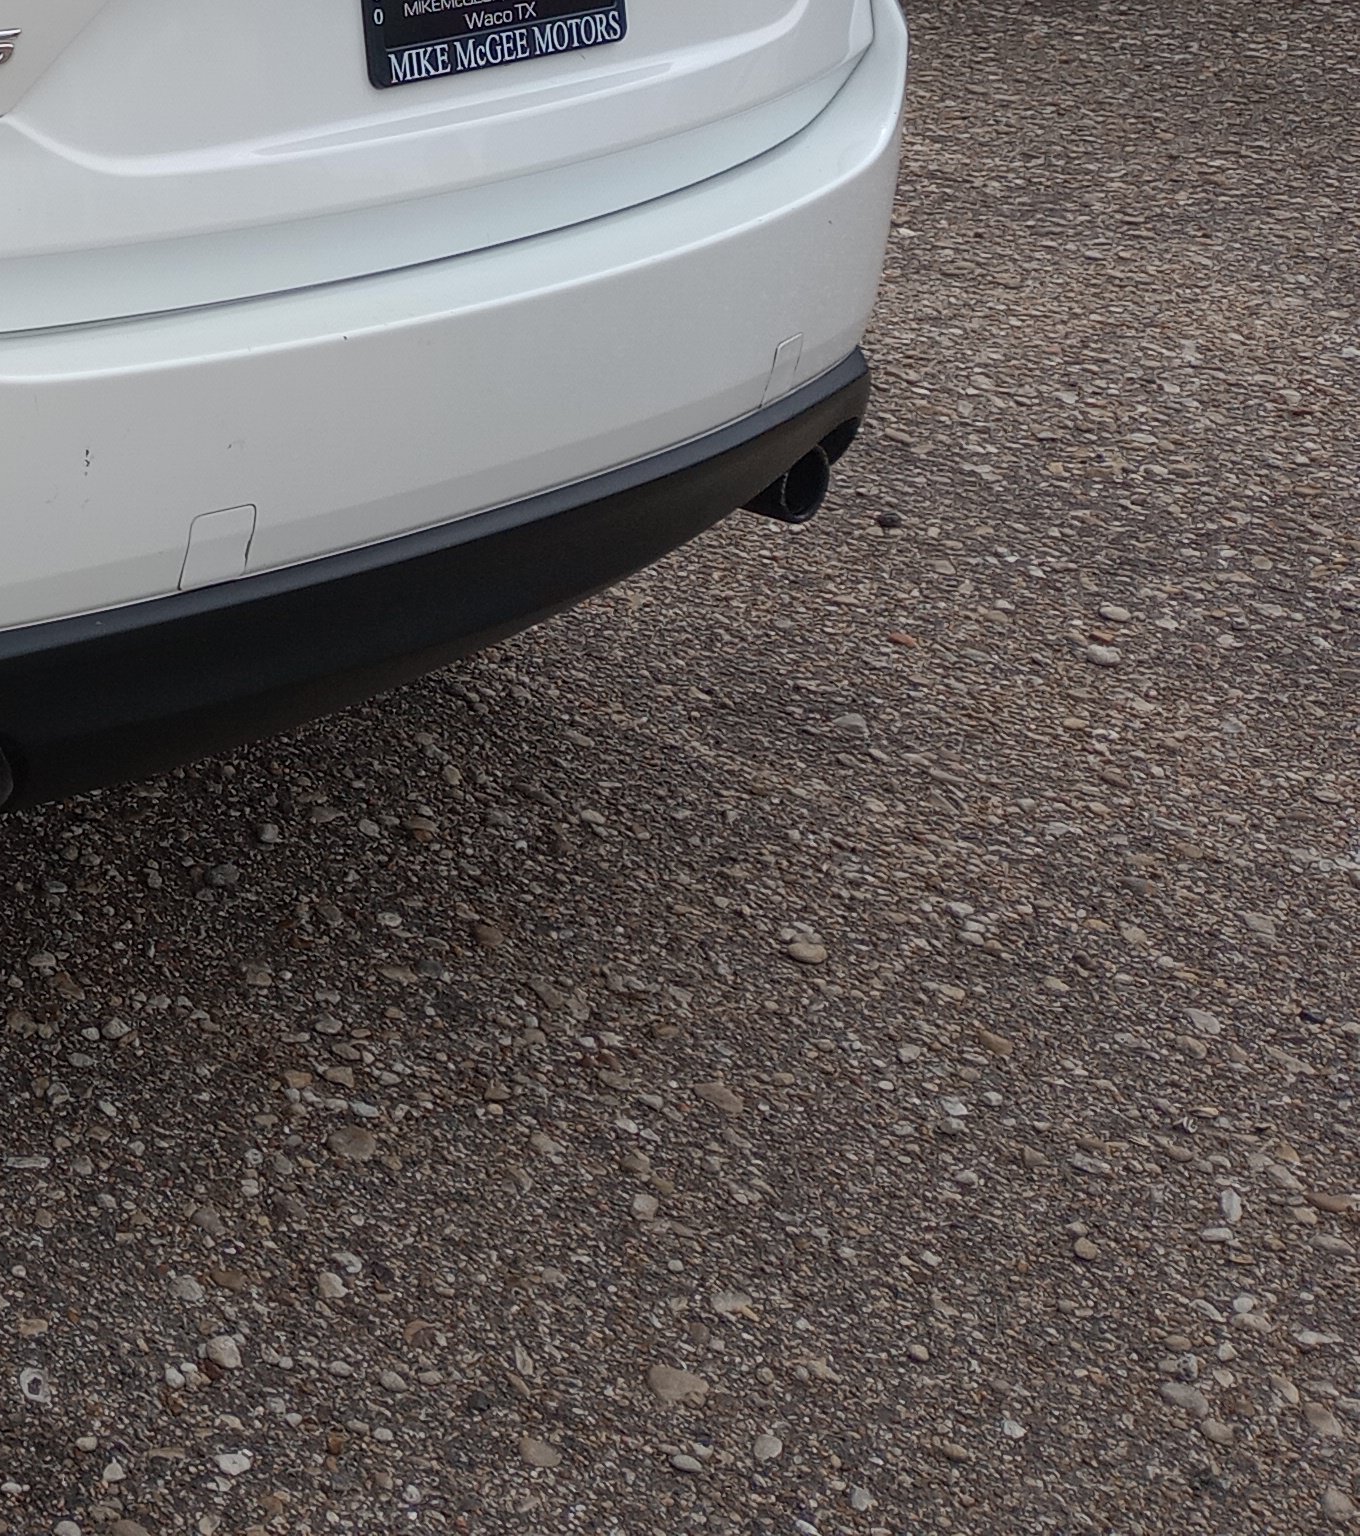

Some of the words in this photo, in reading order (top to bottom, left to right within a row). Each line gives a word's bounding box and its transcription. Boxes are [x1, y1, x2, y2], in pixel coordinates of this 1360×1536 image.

[464, 9, 513, 30] Waco
[514, 1, 537, 21] TX
[388, 43, 451, 84] MIKE
[453, 28, 530, 72] McGEE
[531, 10, 622, 55] MOTORS
